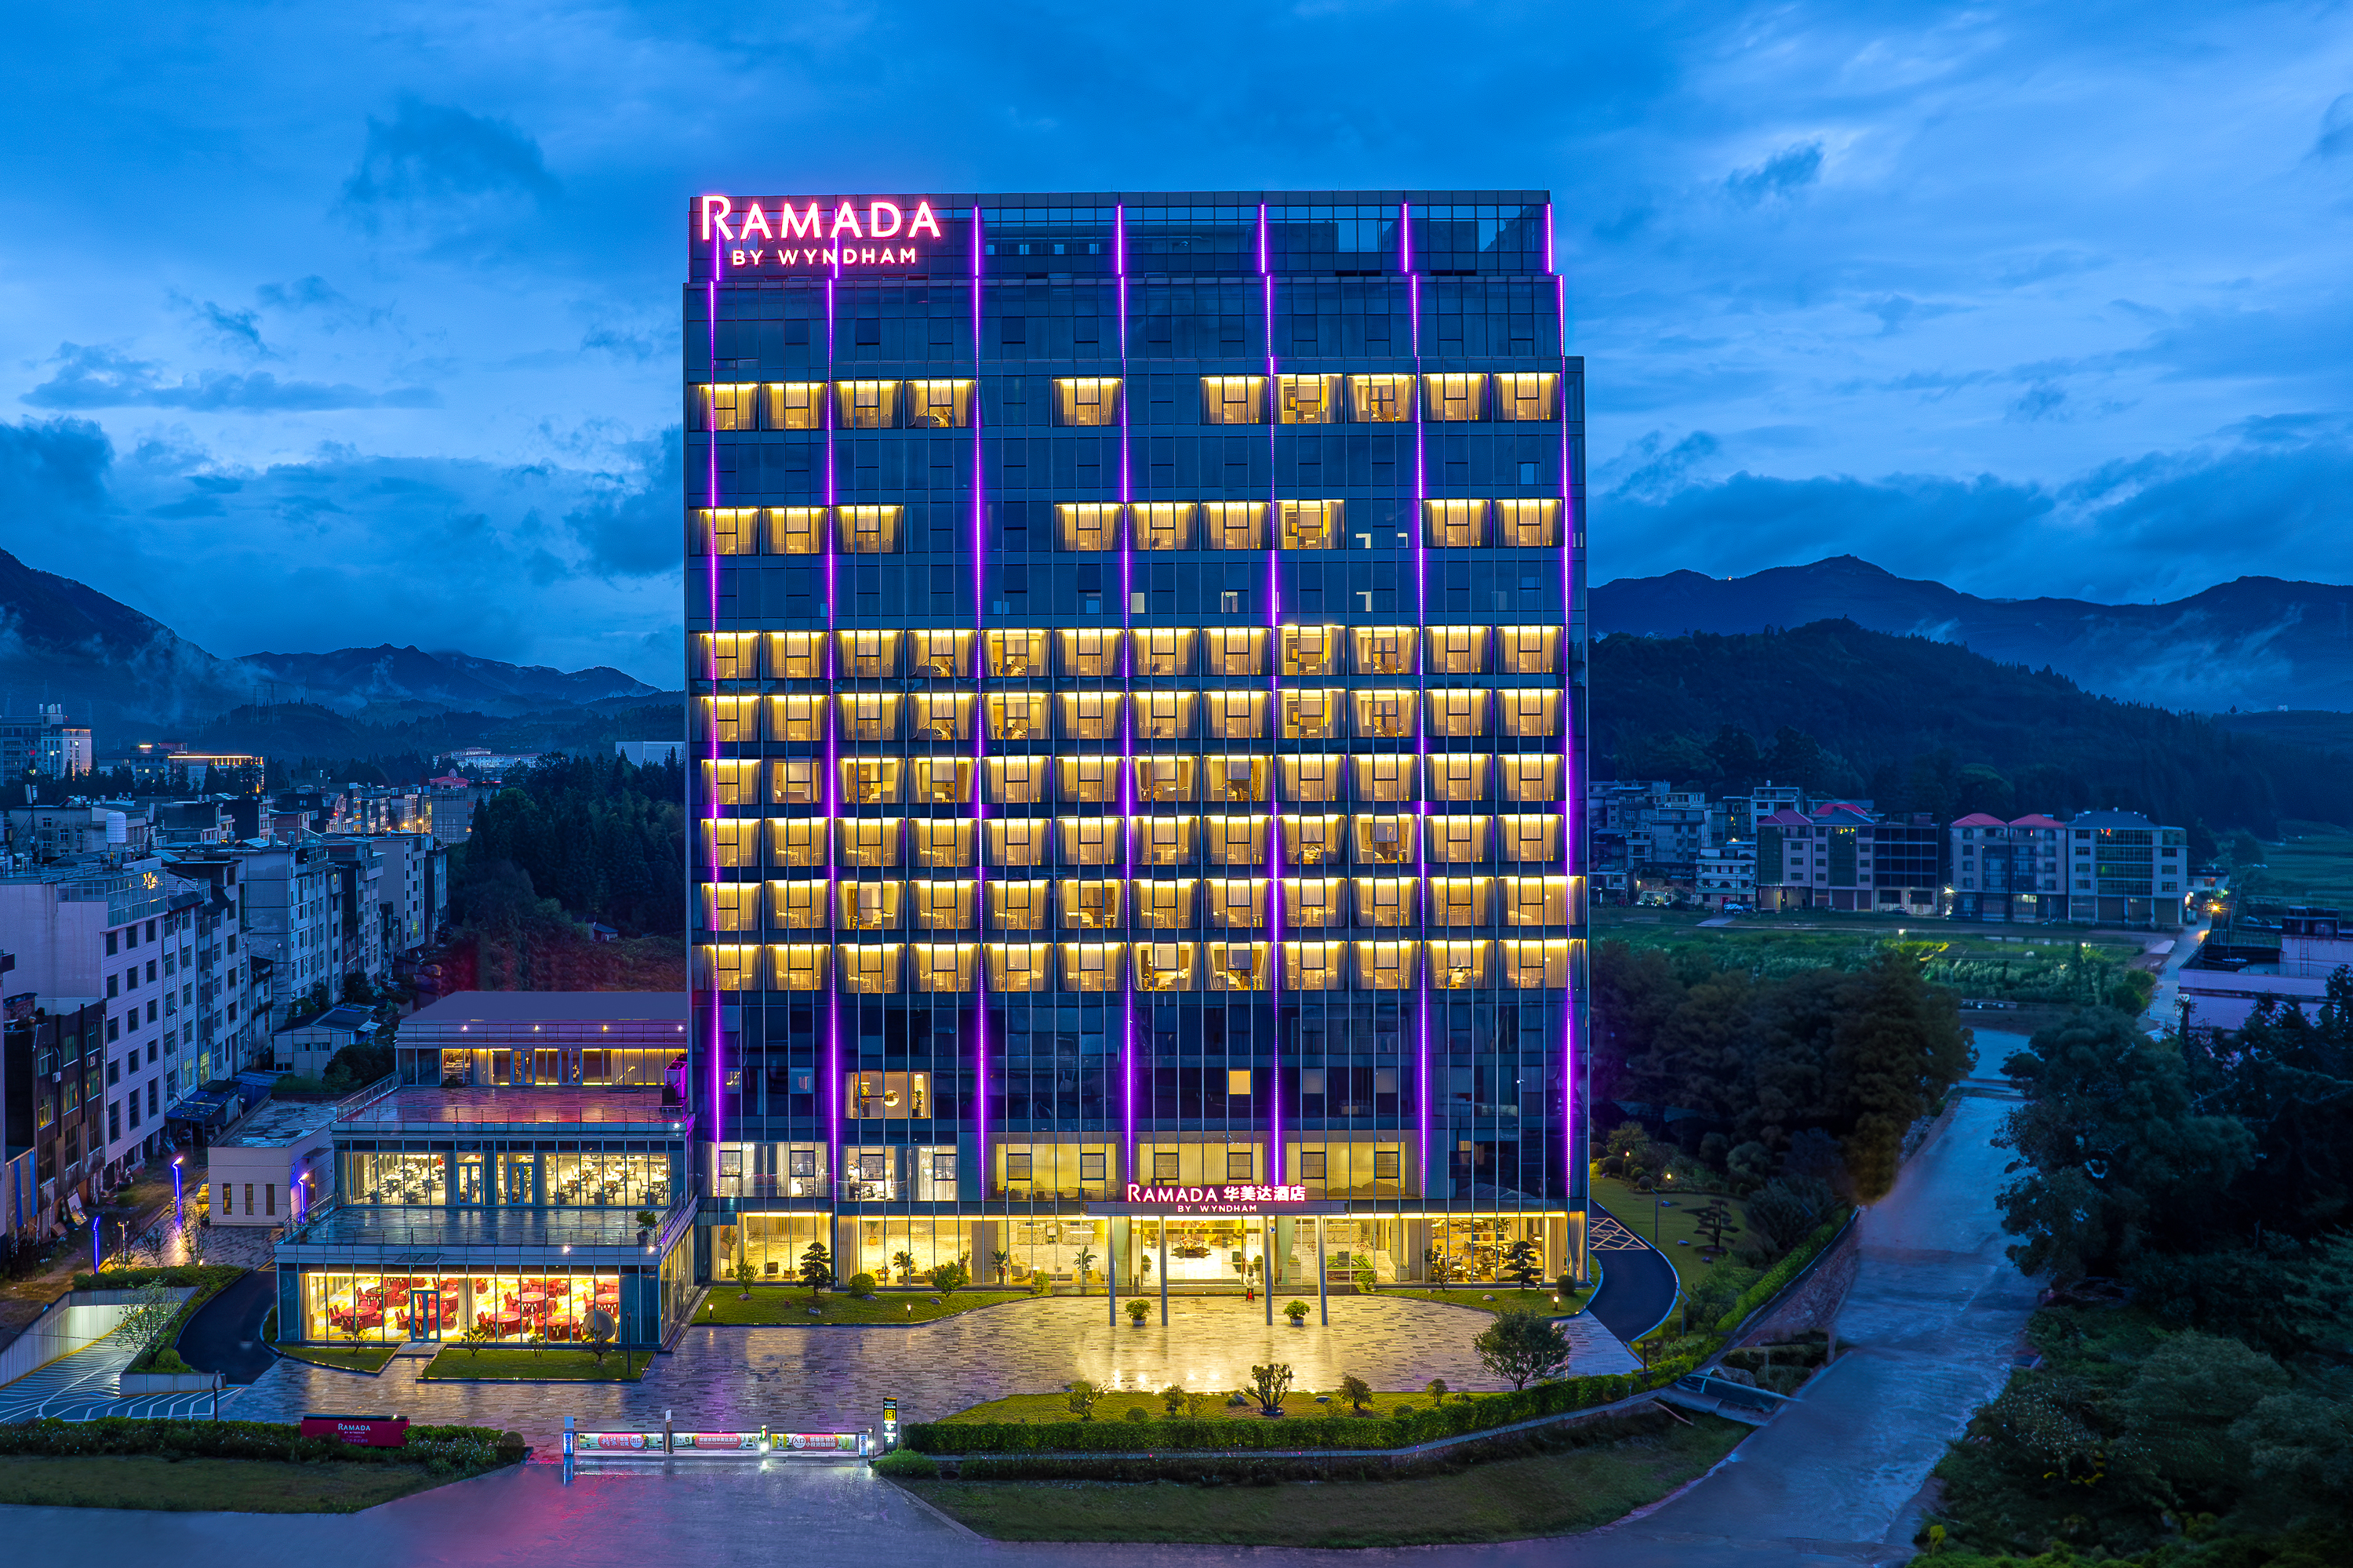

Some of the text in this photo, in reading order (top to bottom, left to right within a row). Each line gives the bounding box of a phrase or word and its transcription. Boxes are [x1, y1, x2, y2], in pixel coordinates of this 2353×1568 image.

[702, 195, 941, 241] RAMADA
[732, 248, 916, 265] BY WYNDHAM
[1127, 1184, 1306, 1202] RAMADA 华美达酒店
[338, 1423, 371, 1432] RAMADA
